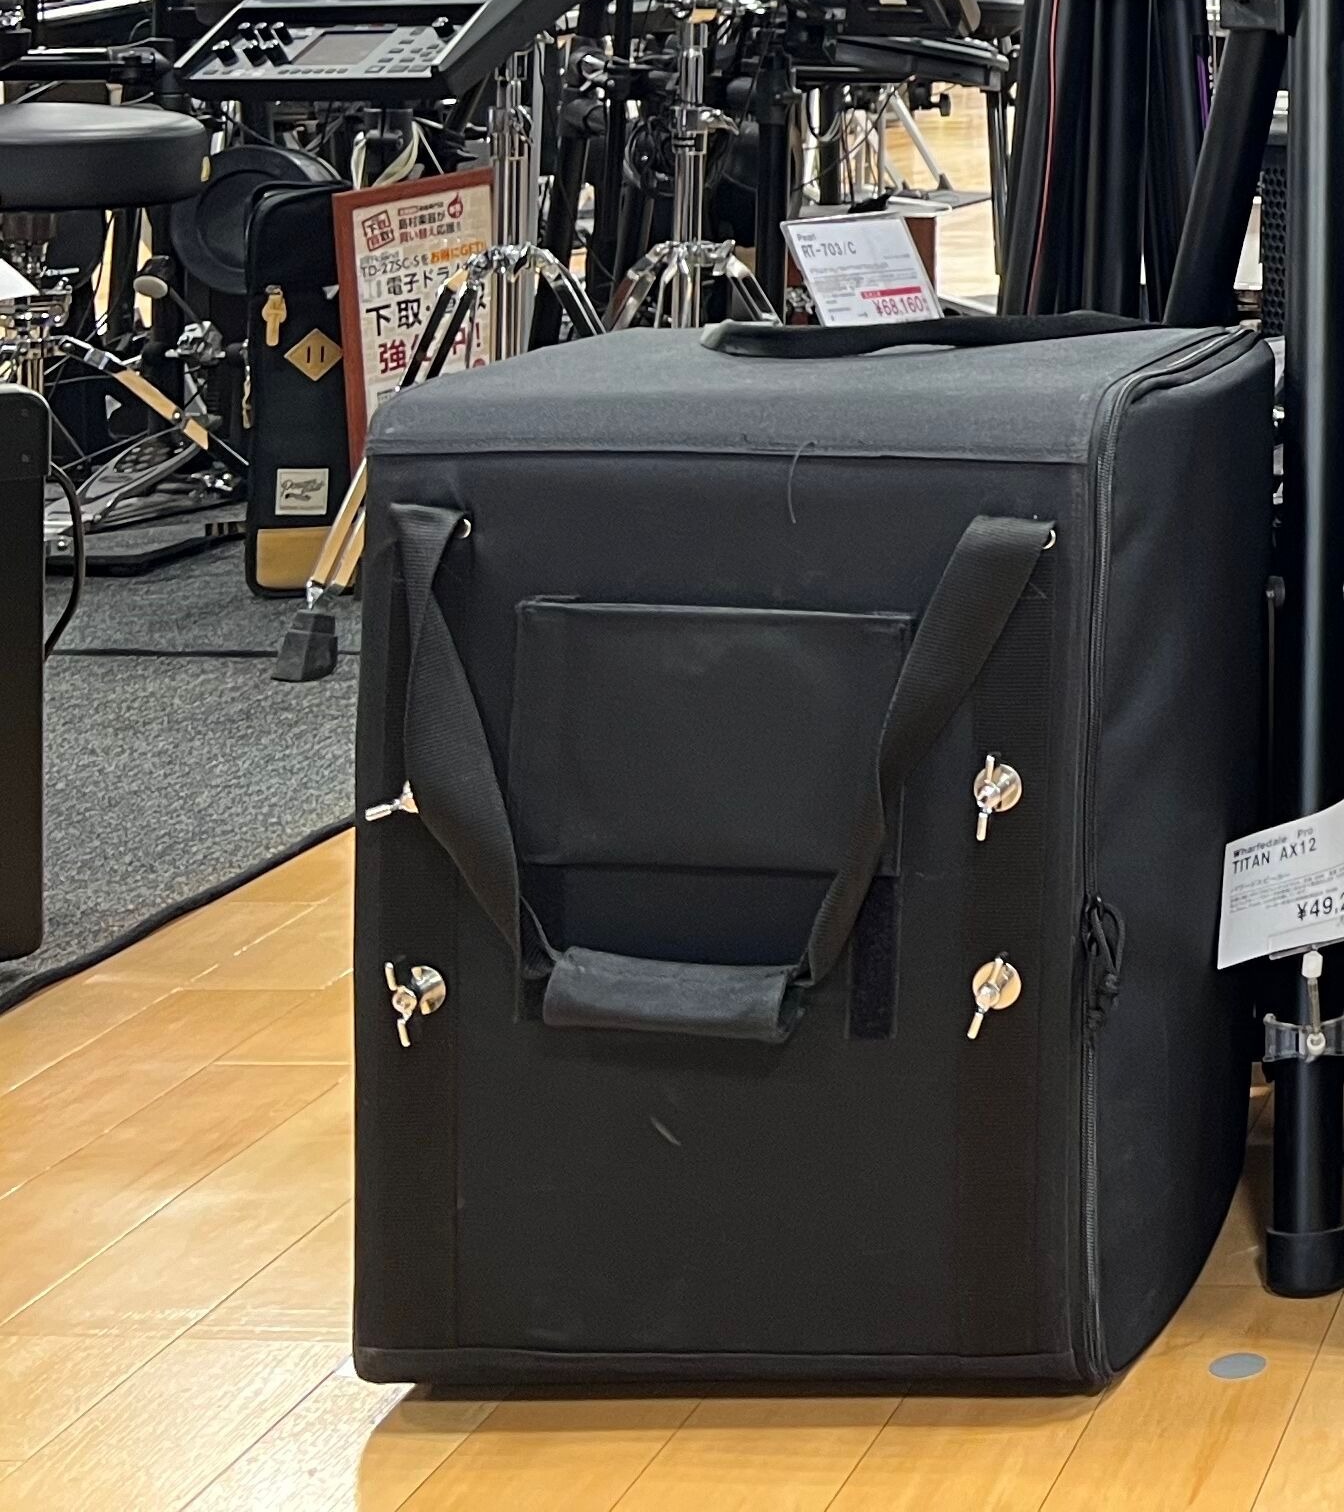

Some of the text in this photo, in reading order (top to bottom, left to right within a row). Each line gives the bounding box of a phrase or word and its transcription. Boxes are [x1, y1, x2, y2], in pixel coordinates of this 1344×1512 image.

[801, 241, 857, 259] RT-703/C
[872, 295, 924, 317] ¥68,160
[1232, 837, 1317, 874] TITAN AX12
